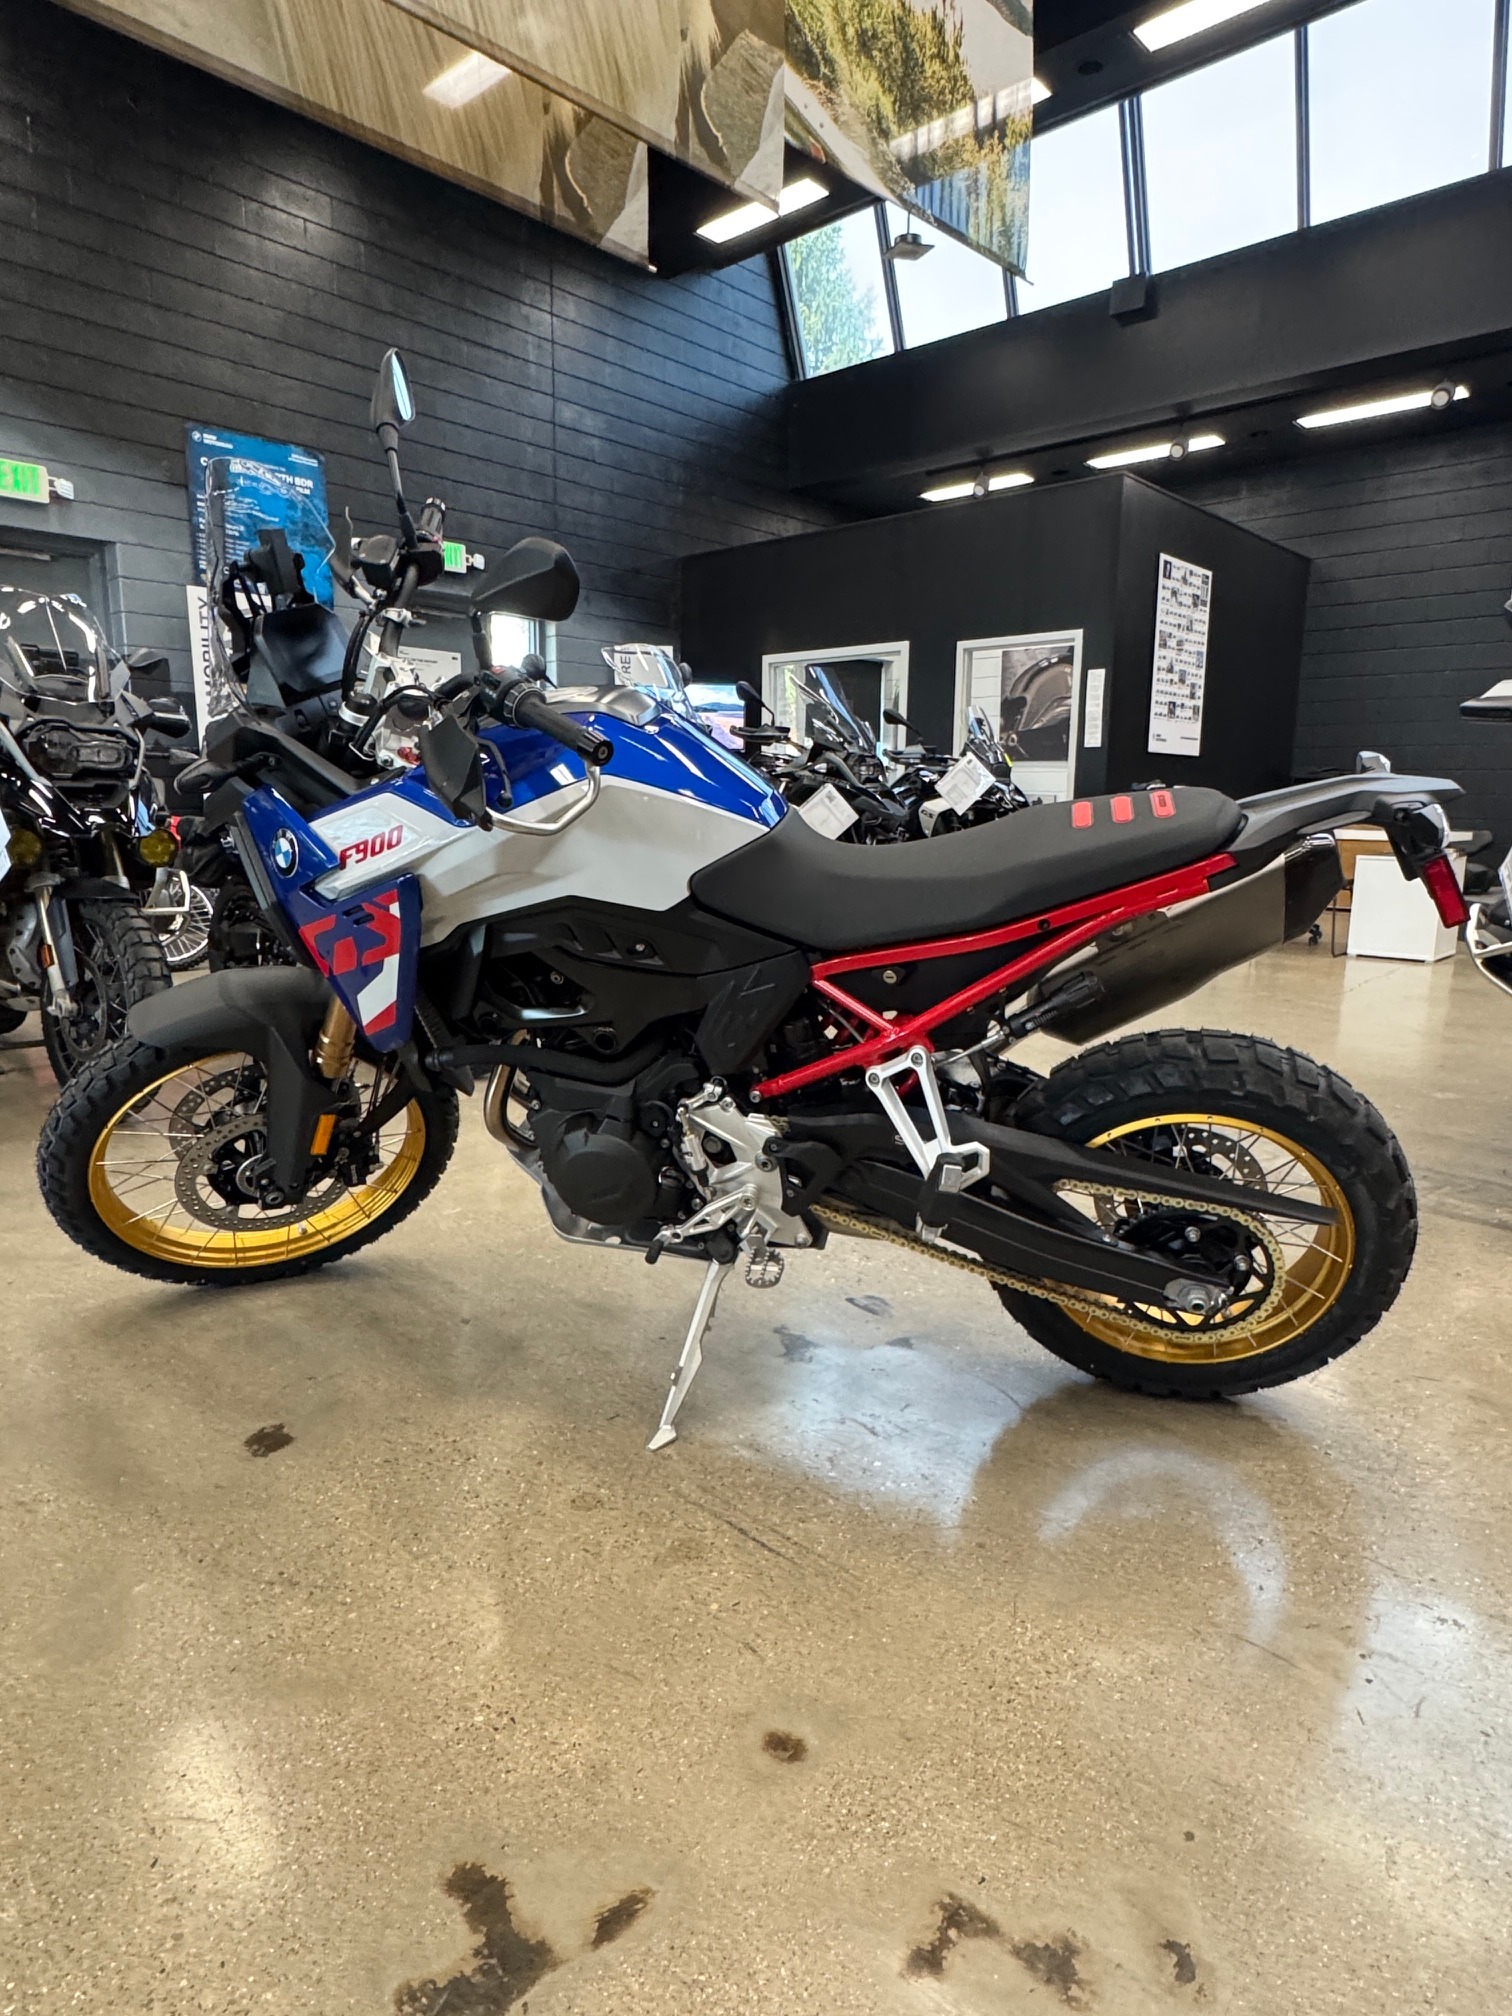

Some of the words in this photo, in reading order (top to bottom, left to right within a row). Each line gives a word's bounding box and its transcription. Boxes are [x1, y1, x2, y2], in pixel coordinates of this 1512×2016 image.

[0, 460, 39, 495] EXIT
[294, 476, 314, 489] BDR
[339, 824, 404, 870] F900
